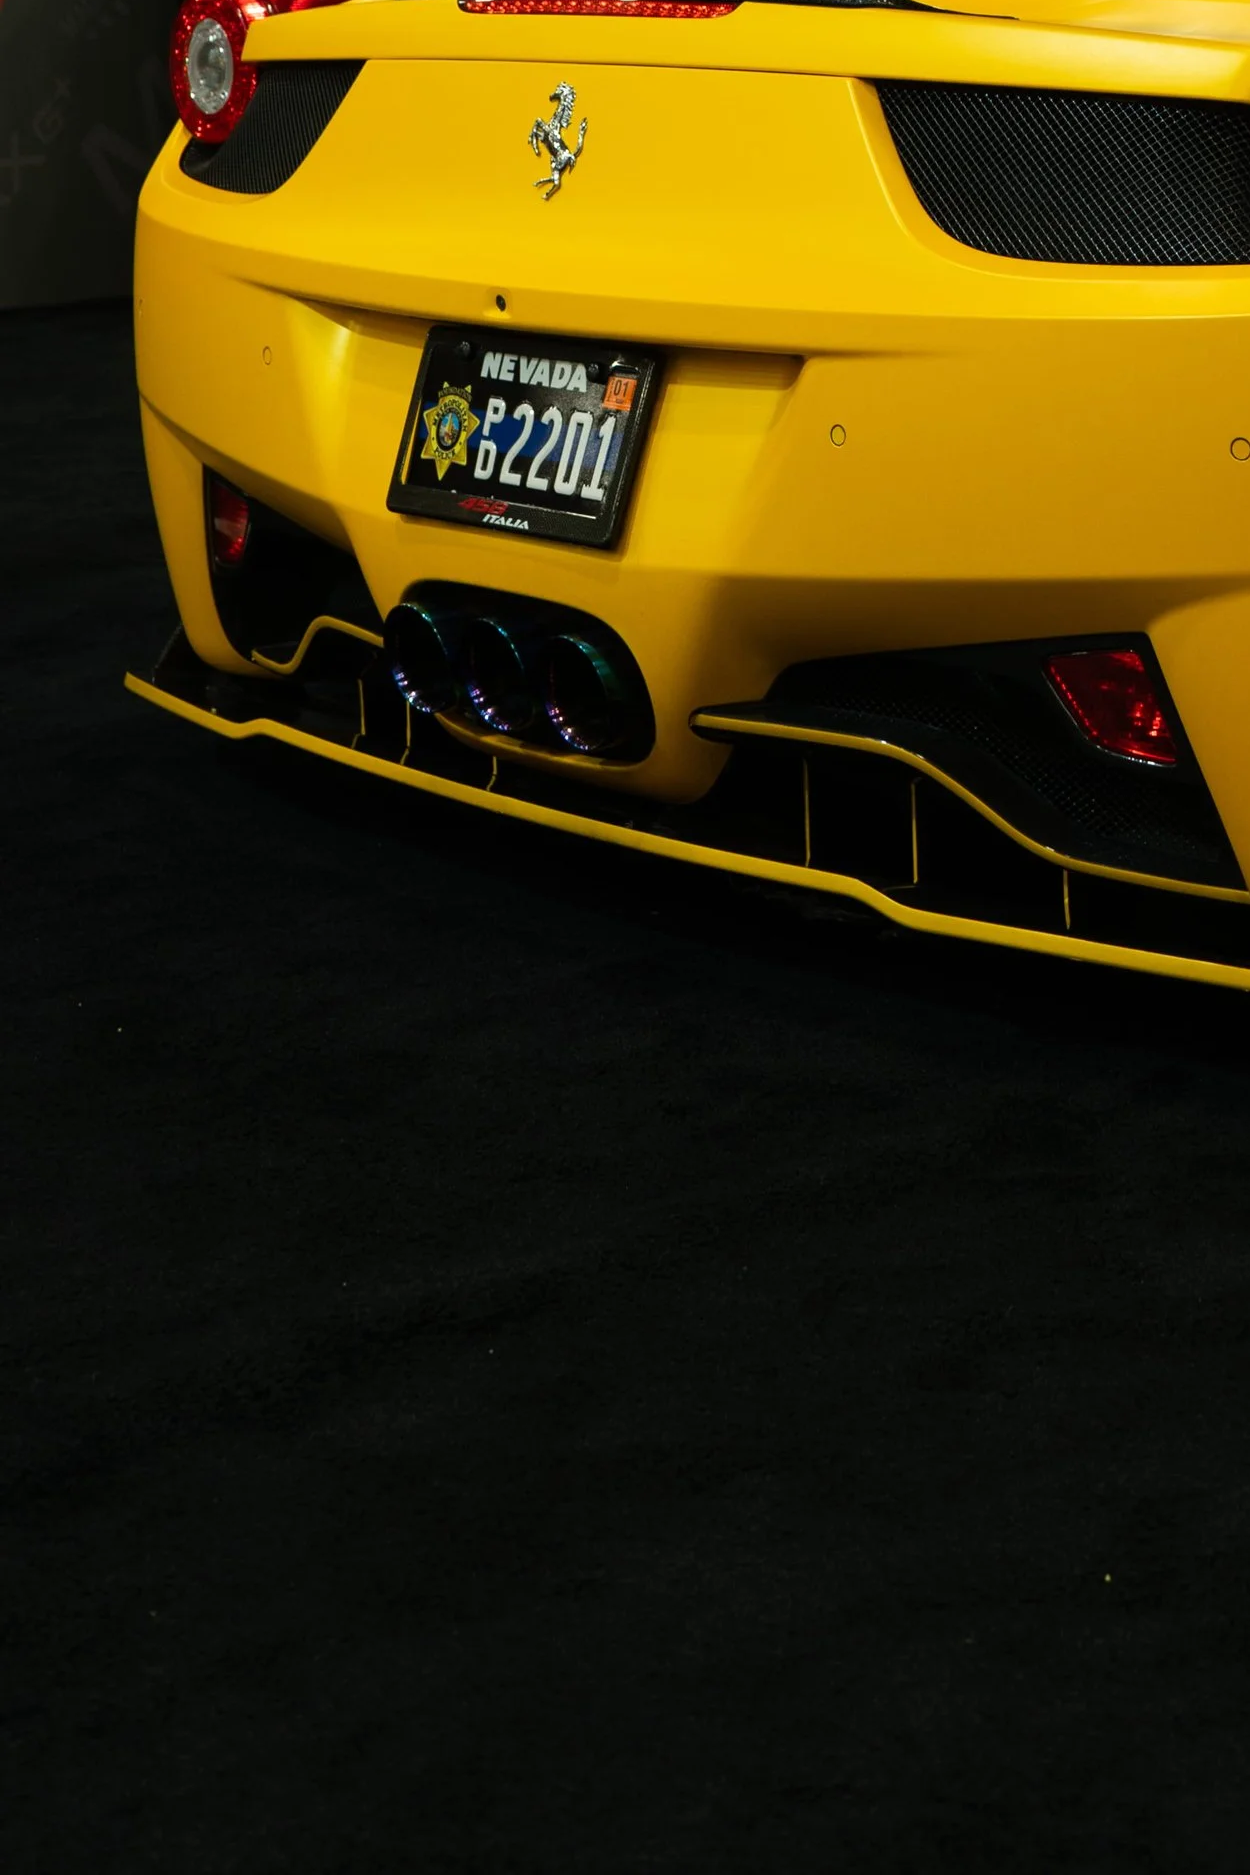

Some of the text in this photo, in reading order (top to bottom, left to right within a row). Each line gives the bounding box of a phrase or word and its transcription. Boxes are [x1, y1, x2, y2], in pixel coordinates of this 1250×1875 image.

[480, 351, 588, 393] NEVADA
[499, 402, 617, 502] 2201
[458, 496, 510, 516] 458
[481, 513, 529, 530] ITALIA
